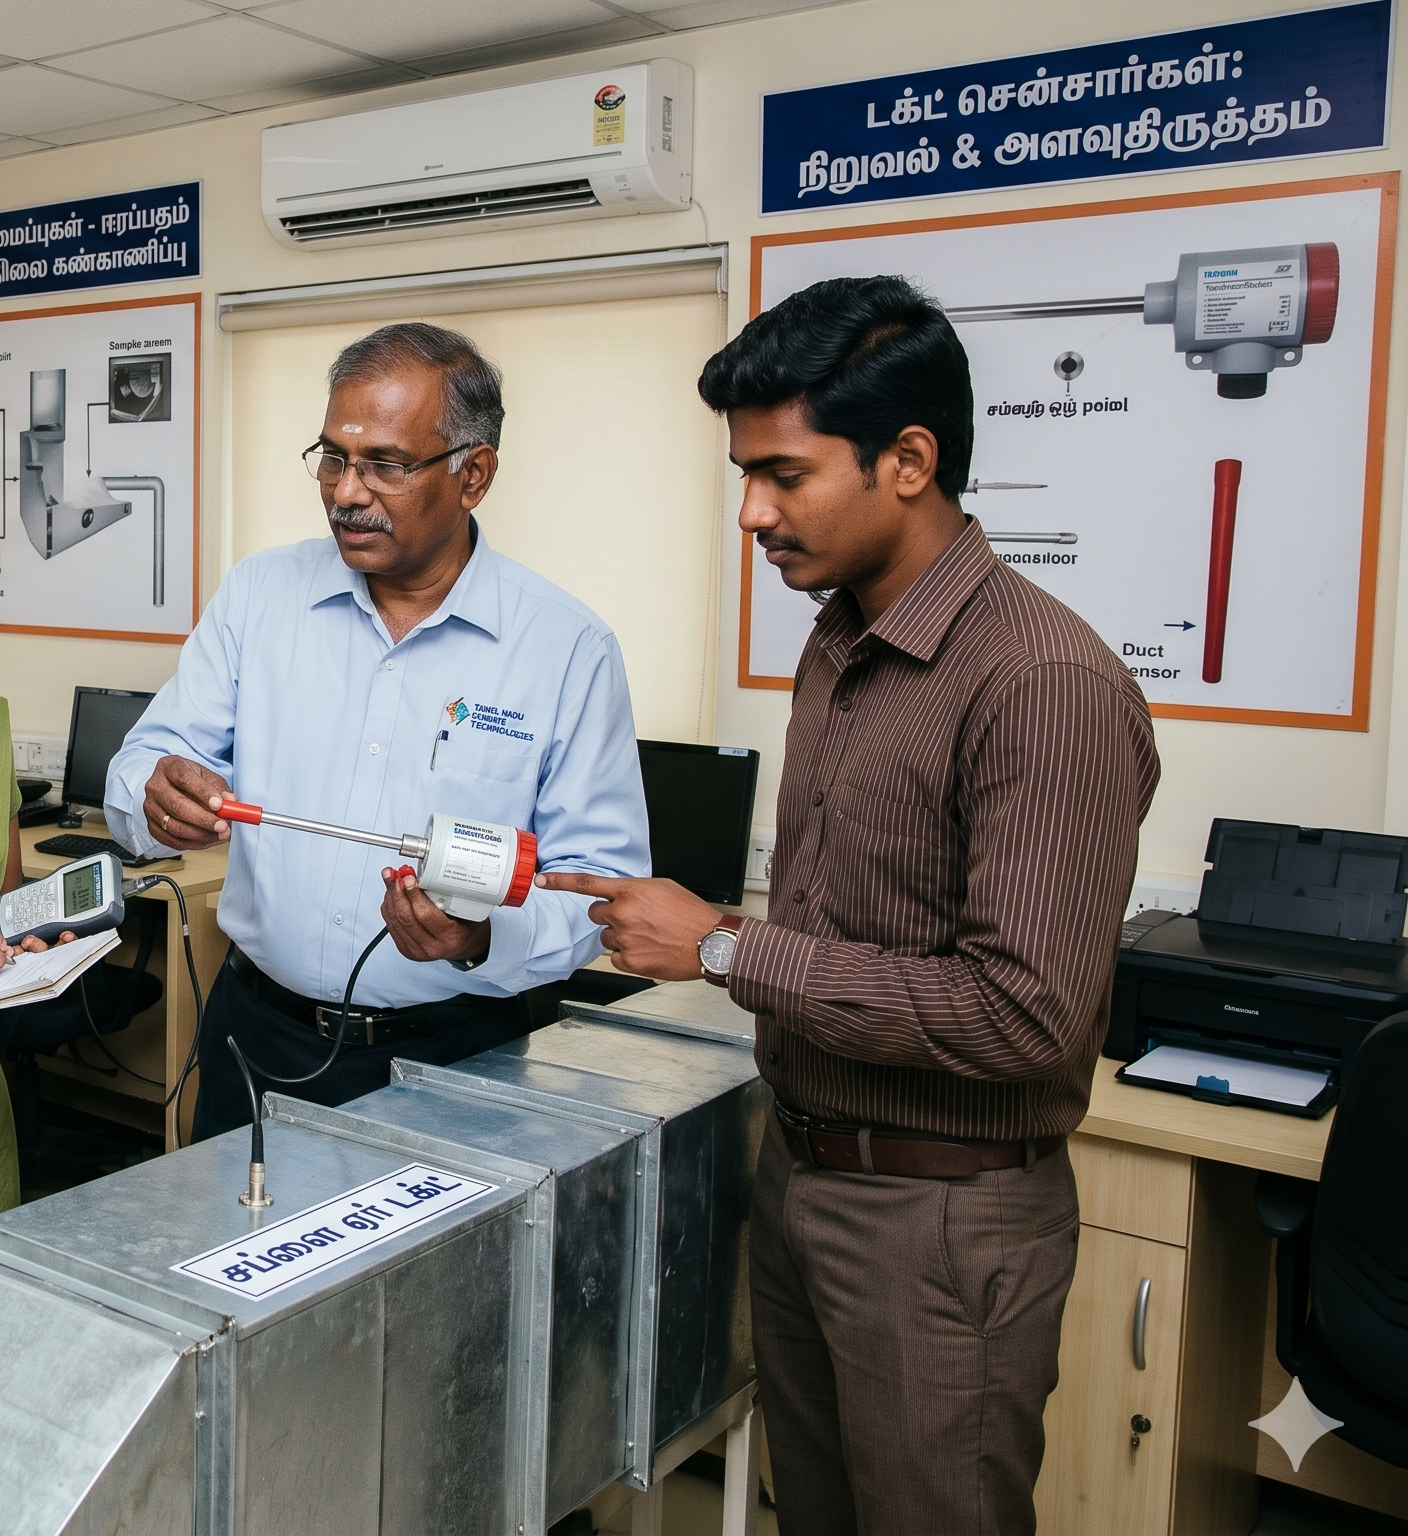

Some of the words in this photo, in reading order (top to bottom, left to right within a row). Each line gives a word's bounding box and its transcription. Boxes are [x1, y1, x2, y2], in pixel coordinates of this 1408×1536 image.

[867, 87, 948, 129] டக்ட்
[958, 42, 1244, 116] சென்சார்கள்:
[797, 136, 940, 199] நிறுவல்
[952, 133, 982, 170] &
[994, 86, 1332, 166] அளவுதிருத்தம்
[101, 196, 190, 237] ஈரப்பதம்
[52, 236, 186, 276] கண்காணிப்பு
[1122, 642, 1164, 658] Duct
[1129, 666, 1181, 679] ensor
[221, 1226, 347, 1283] சப்ளை
[341, 1202, 395, 1231] ஏர்
[383, 1175, 463, 1210] டக்ட்
